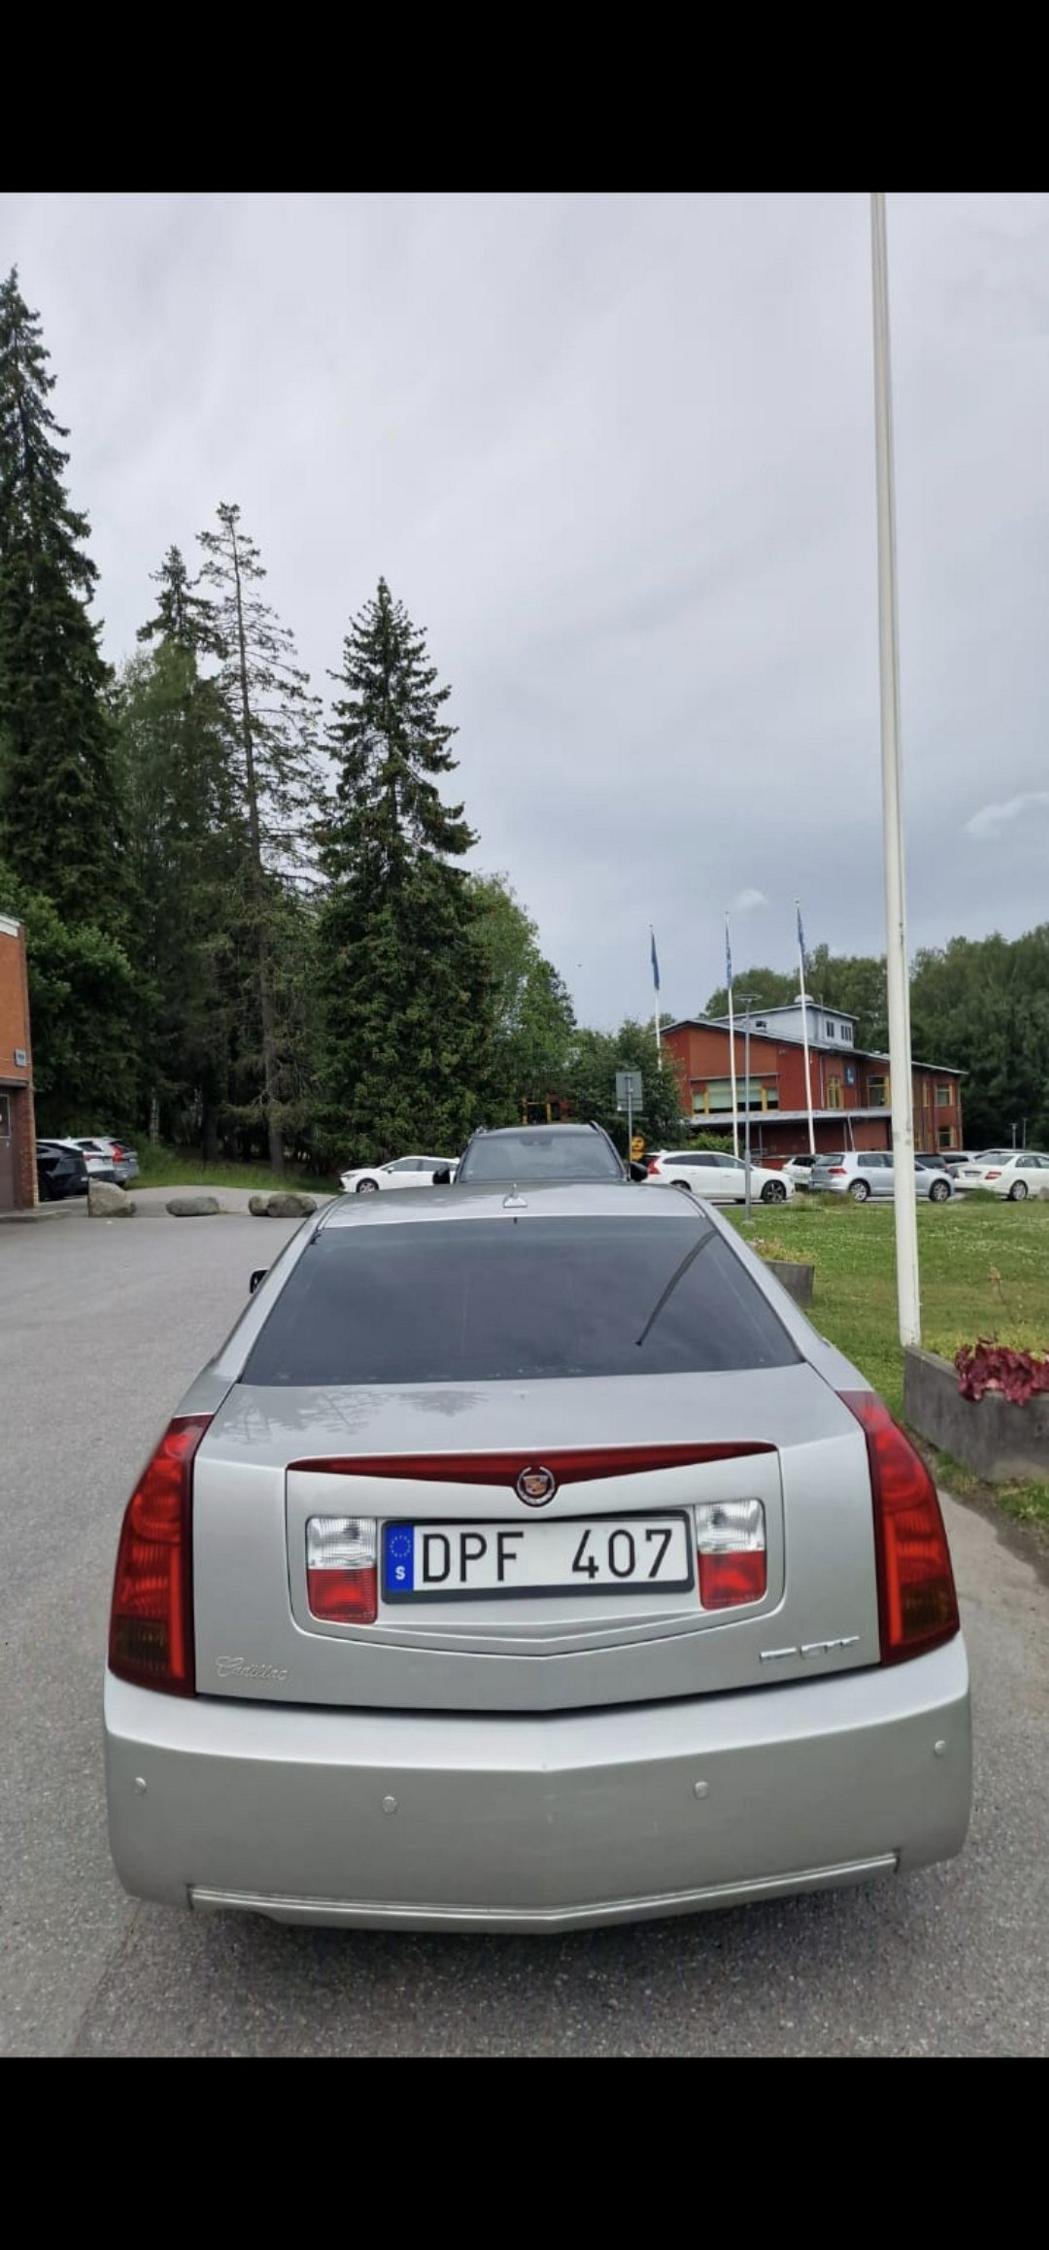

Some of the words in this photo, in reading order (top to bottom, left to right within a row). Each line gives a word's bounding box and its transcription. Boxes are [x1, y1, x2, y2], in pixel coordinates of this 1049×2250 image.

[394, 1566, 406, 1580] S
[422, 1532, 525, 1582] DPF
[572, 1529, 673, 1579] 407
